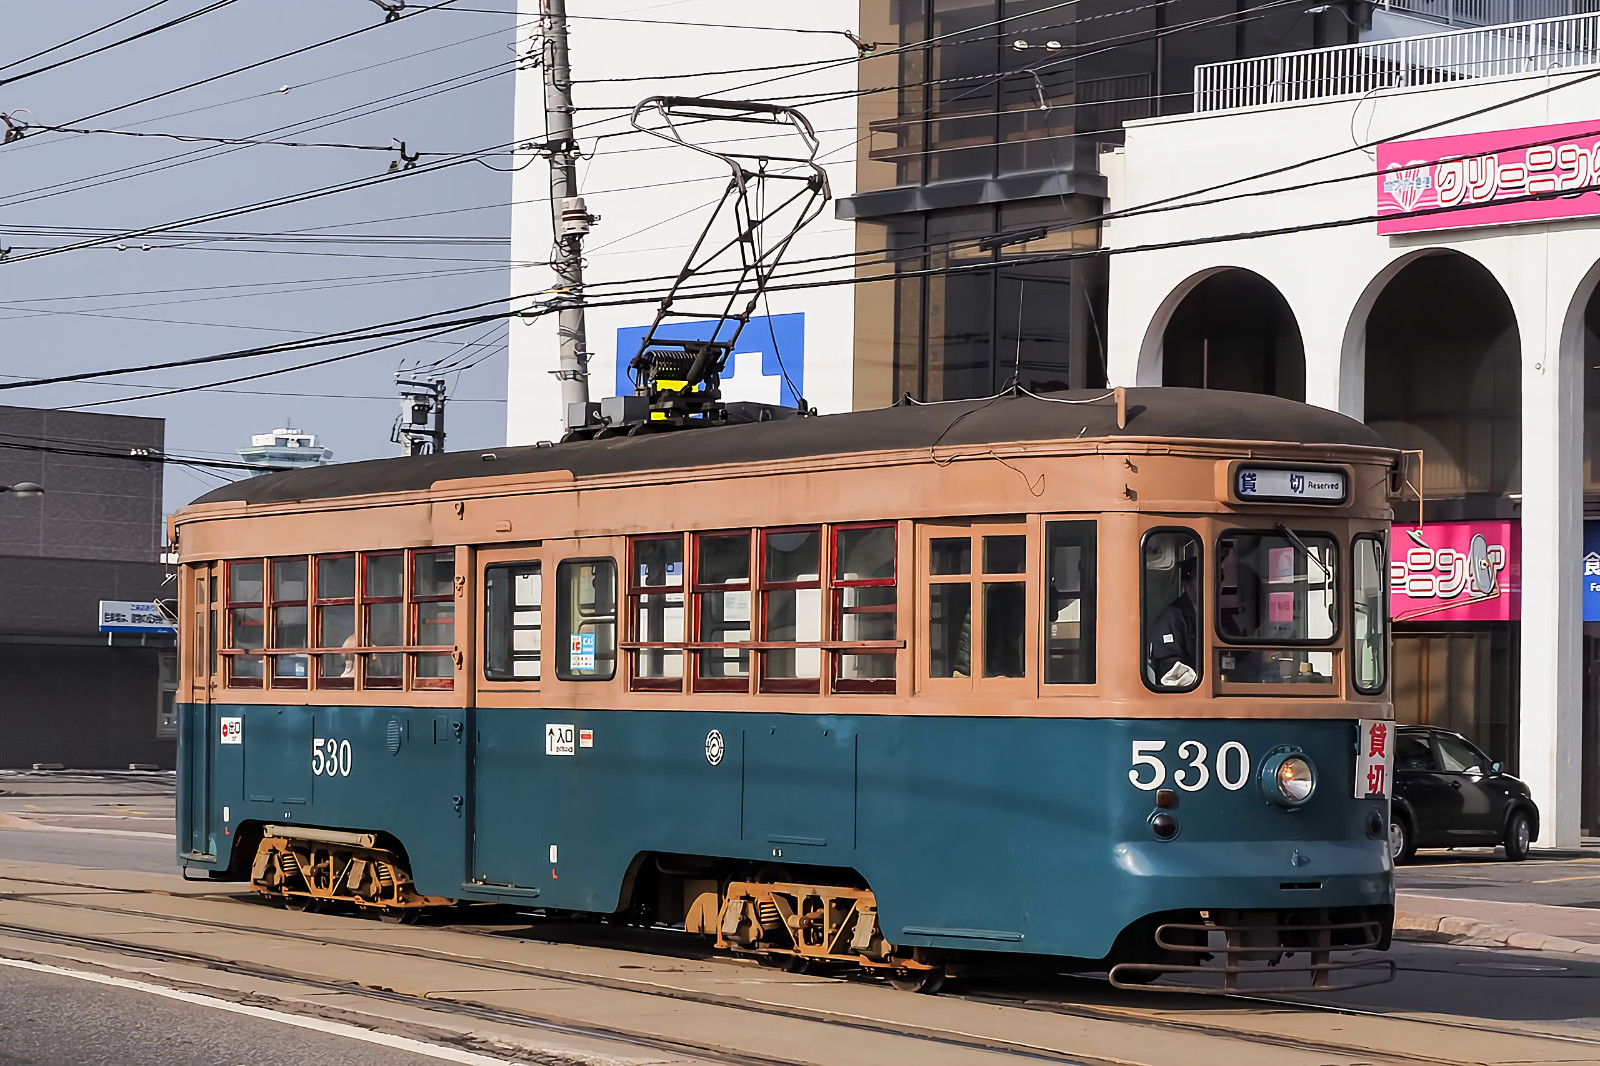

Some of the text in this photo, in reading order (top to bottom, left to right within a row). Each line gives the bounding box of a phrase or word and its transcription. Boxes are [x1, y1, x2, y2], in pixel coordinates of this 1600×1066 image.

[1435, 144, 1600, 206] クリーニン
[1308, 481, 1339, 490] Reserved
[312, 738, 352, 776] 530
[557, 728, 573, 743] 入口
[1128, 740, 1250, 792] 530
[1367, 722, 1388, 795] 貸切
